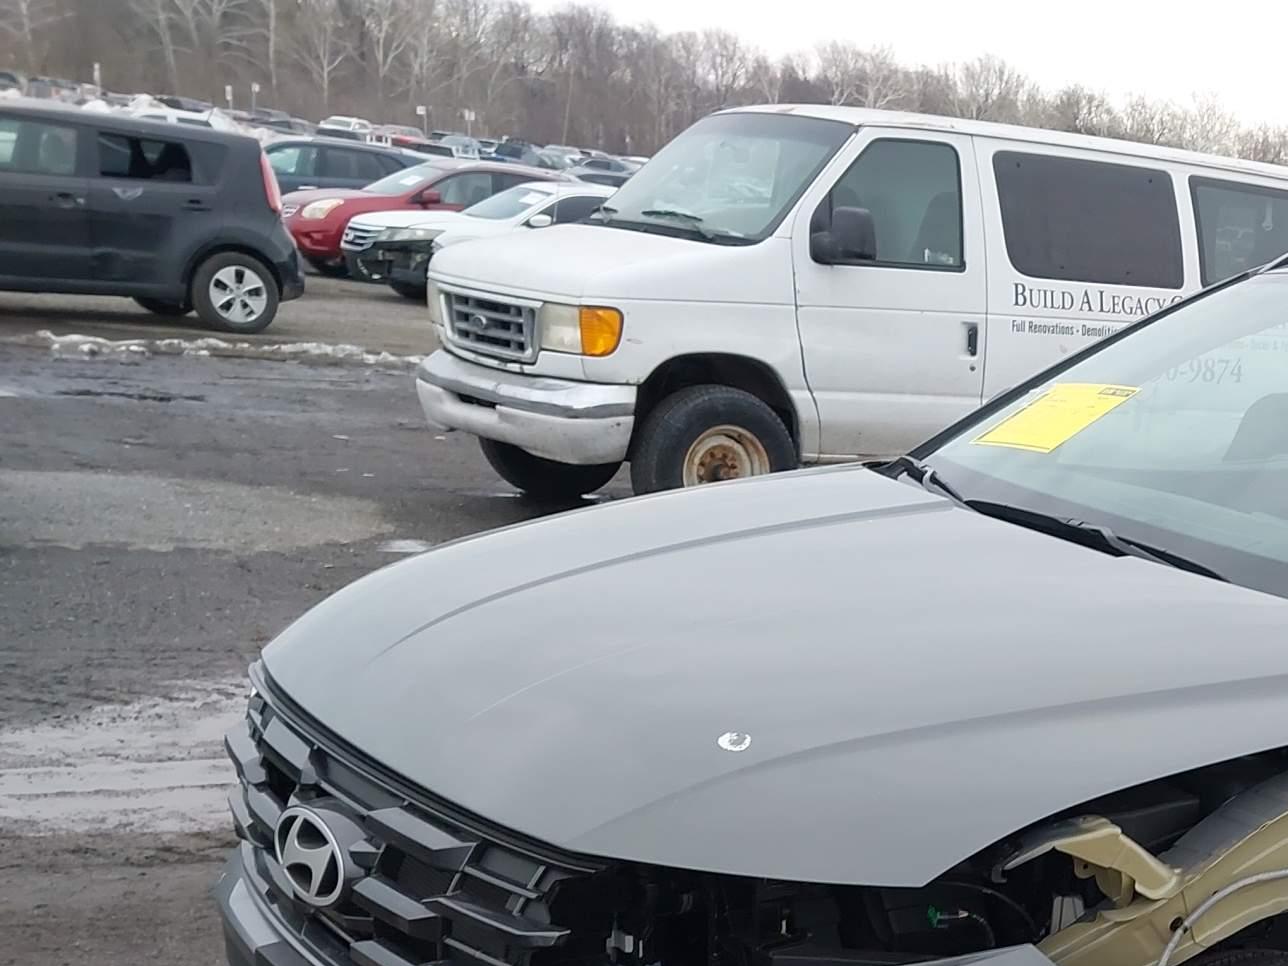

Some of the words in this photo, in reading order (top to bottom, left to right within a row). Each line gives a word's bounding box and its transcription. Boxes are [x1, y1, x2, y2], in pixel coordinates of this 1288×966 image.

[1013, 282, 1075, 311] BUILD
[1079, 288, 1093, 313] A
[1011, 319, 1026, 334] Full
[1028, 320, 1075, 337] Renovations
